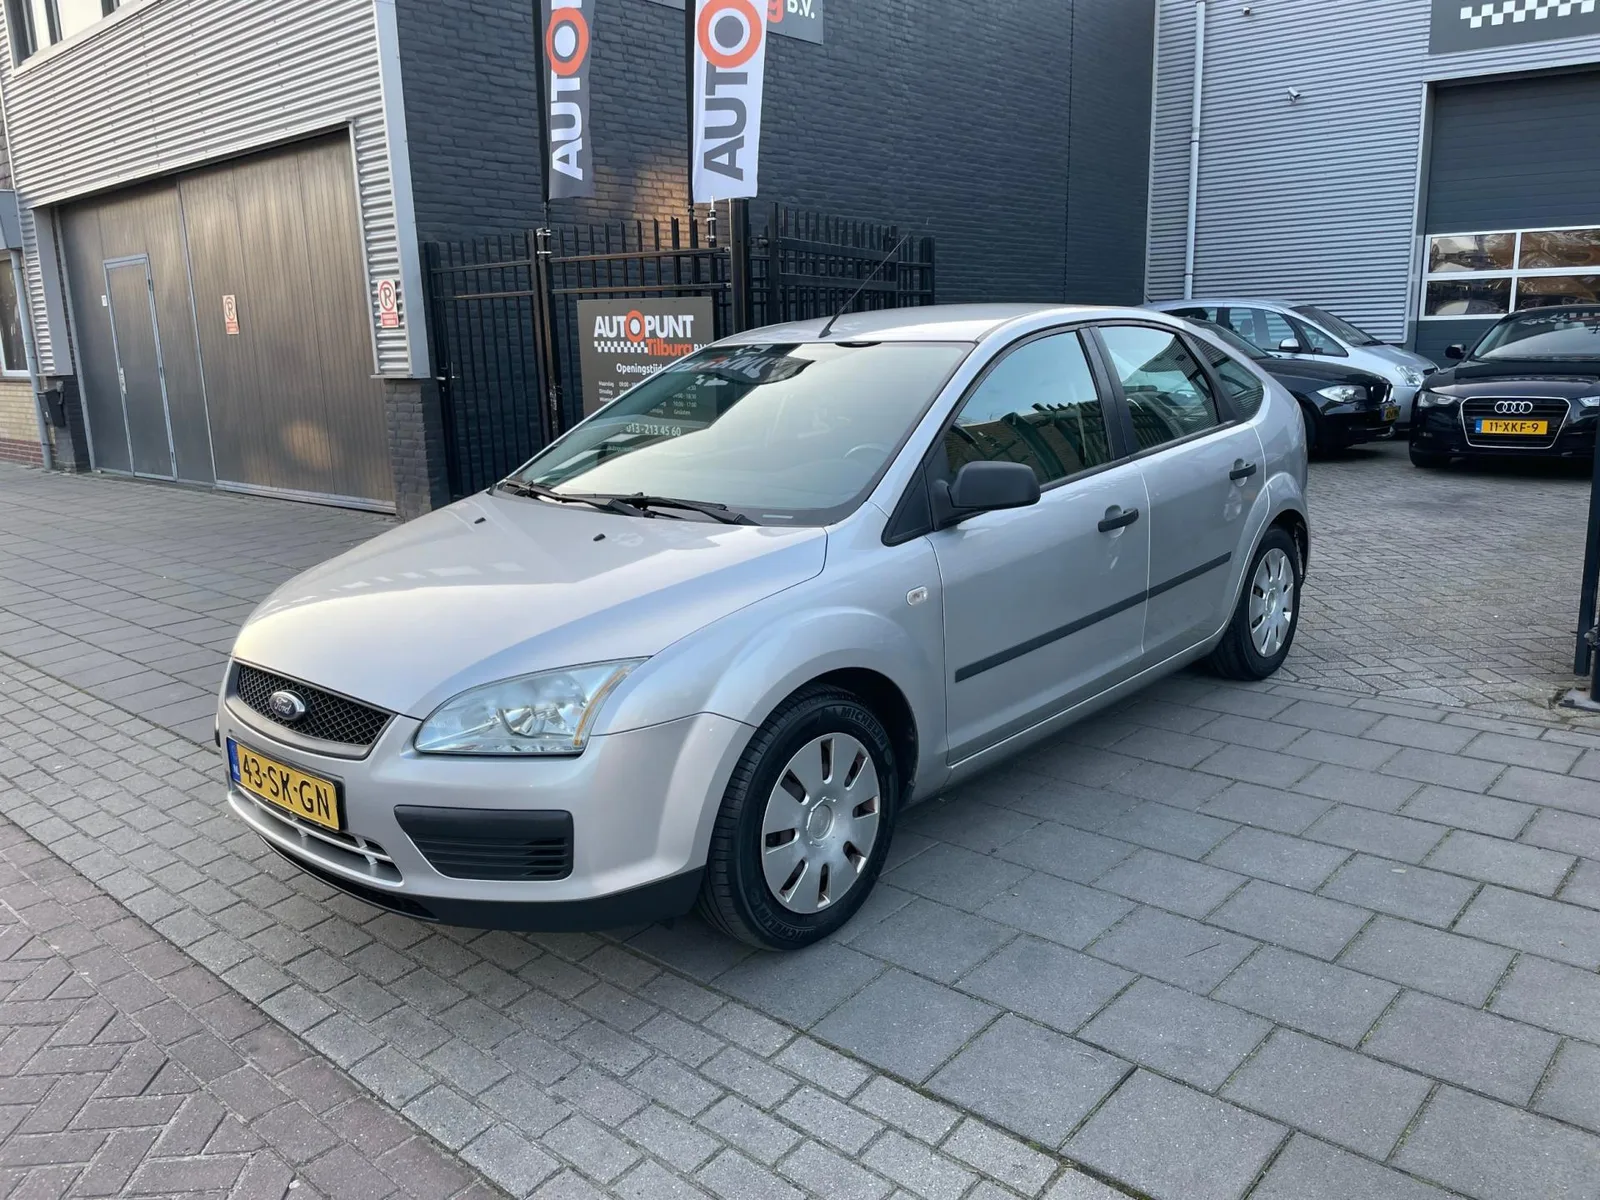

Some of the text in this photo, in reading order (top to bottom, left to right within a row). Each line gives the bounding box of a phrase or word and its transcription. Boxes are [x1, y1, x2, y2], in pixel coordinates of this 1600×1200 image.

[546, 0, 589, 181] AUTO
[698, 0, 762, 181] AUTO
[593, 310, 694, 343] AUTOPUNT
[660, 426, 670, 436] 45
[671, 427, 682, 437] 60
[1489, 421, 1539, 433] 11-XKF-9
[274, 697, 292, 715] Ford
[243, 753, 331, 821] 43-SK-GN
